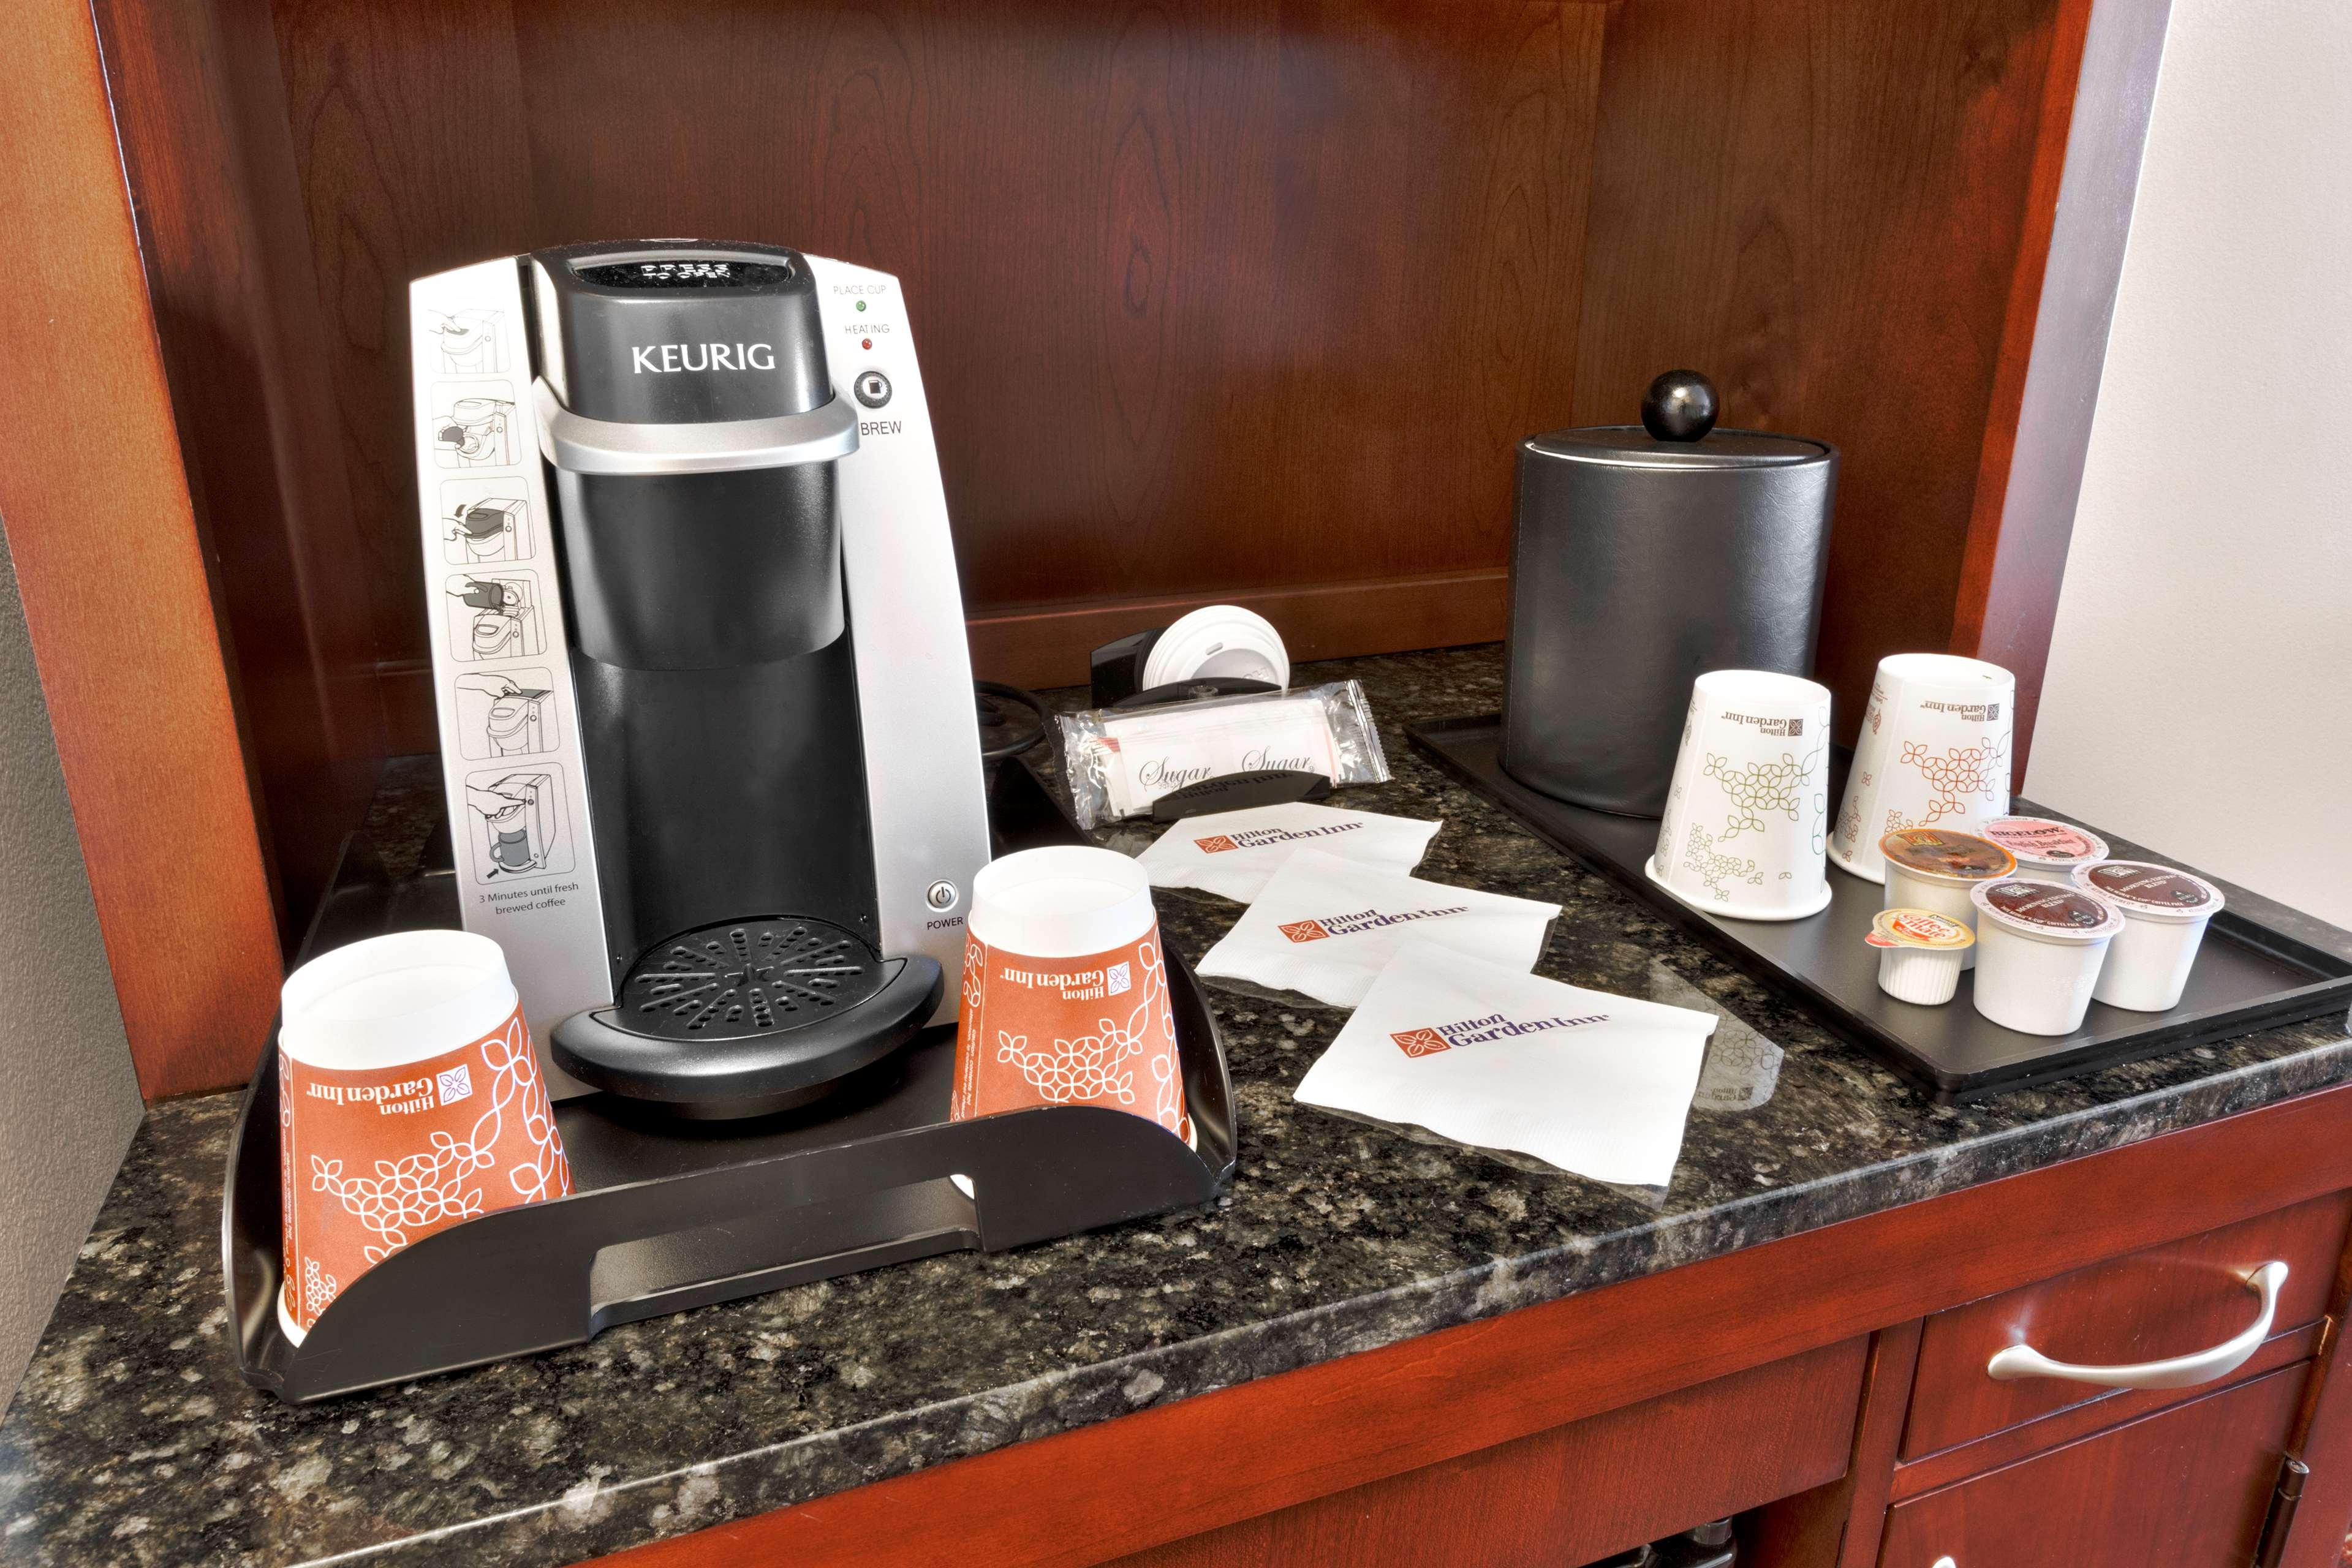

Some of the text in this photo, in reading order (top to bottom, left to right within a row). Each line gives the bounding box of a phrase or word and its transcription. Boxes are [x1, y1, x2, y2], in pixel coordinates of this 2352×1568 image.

[641, 264, 730, 273] PRESS
[833, 285, 887, 295] PLACE CUP
[844, 324, 890, 334] HEATING
[632, 344, 776, 374] KEURIG
[860, 421, 901, 435] BREW
[1947, 704, 1986, 714] Garden
[1745, 715, 1788, 729] Garden
[1760, 727, 1787, 736] Hilton
[1139, 756, 1211, 791] Sugar
[1231, 828, 1283, 841] Hilton
[1238, 830, 1323, 848] Garden
[479, 883, 579, 903] 3 Minutes until fresh
[496, 898, 566, 914] brewed coffee
[927, 917, 963, 930] POWER
[1319, 909, 1378, 927] Hilton
[1327, 913, 1423, 935] Garden
[1036, 970, 1105, 990] Garden
[1062, 986, 1105, 1001] Hilton
[1436, 1014, 1507, 1036] Hilton
[1448, 1021, 1558, 1046] Garden
[345, 1077, 434, 1105] Garden
[379, 1095, 435, 1115] Hilton
